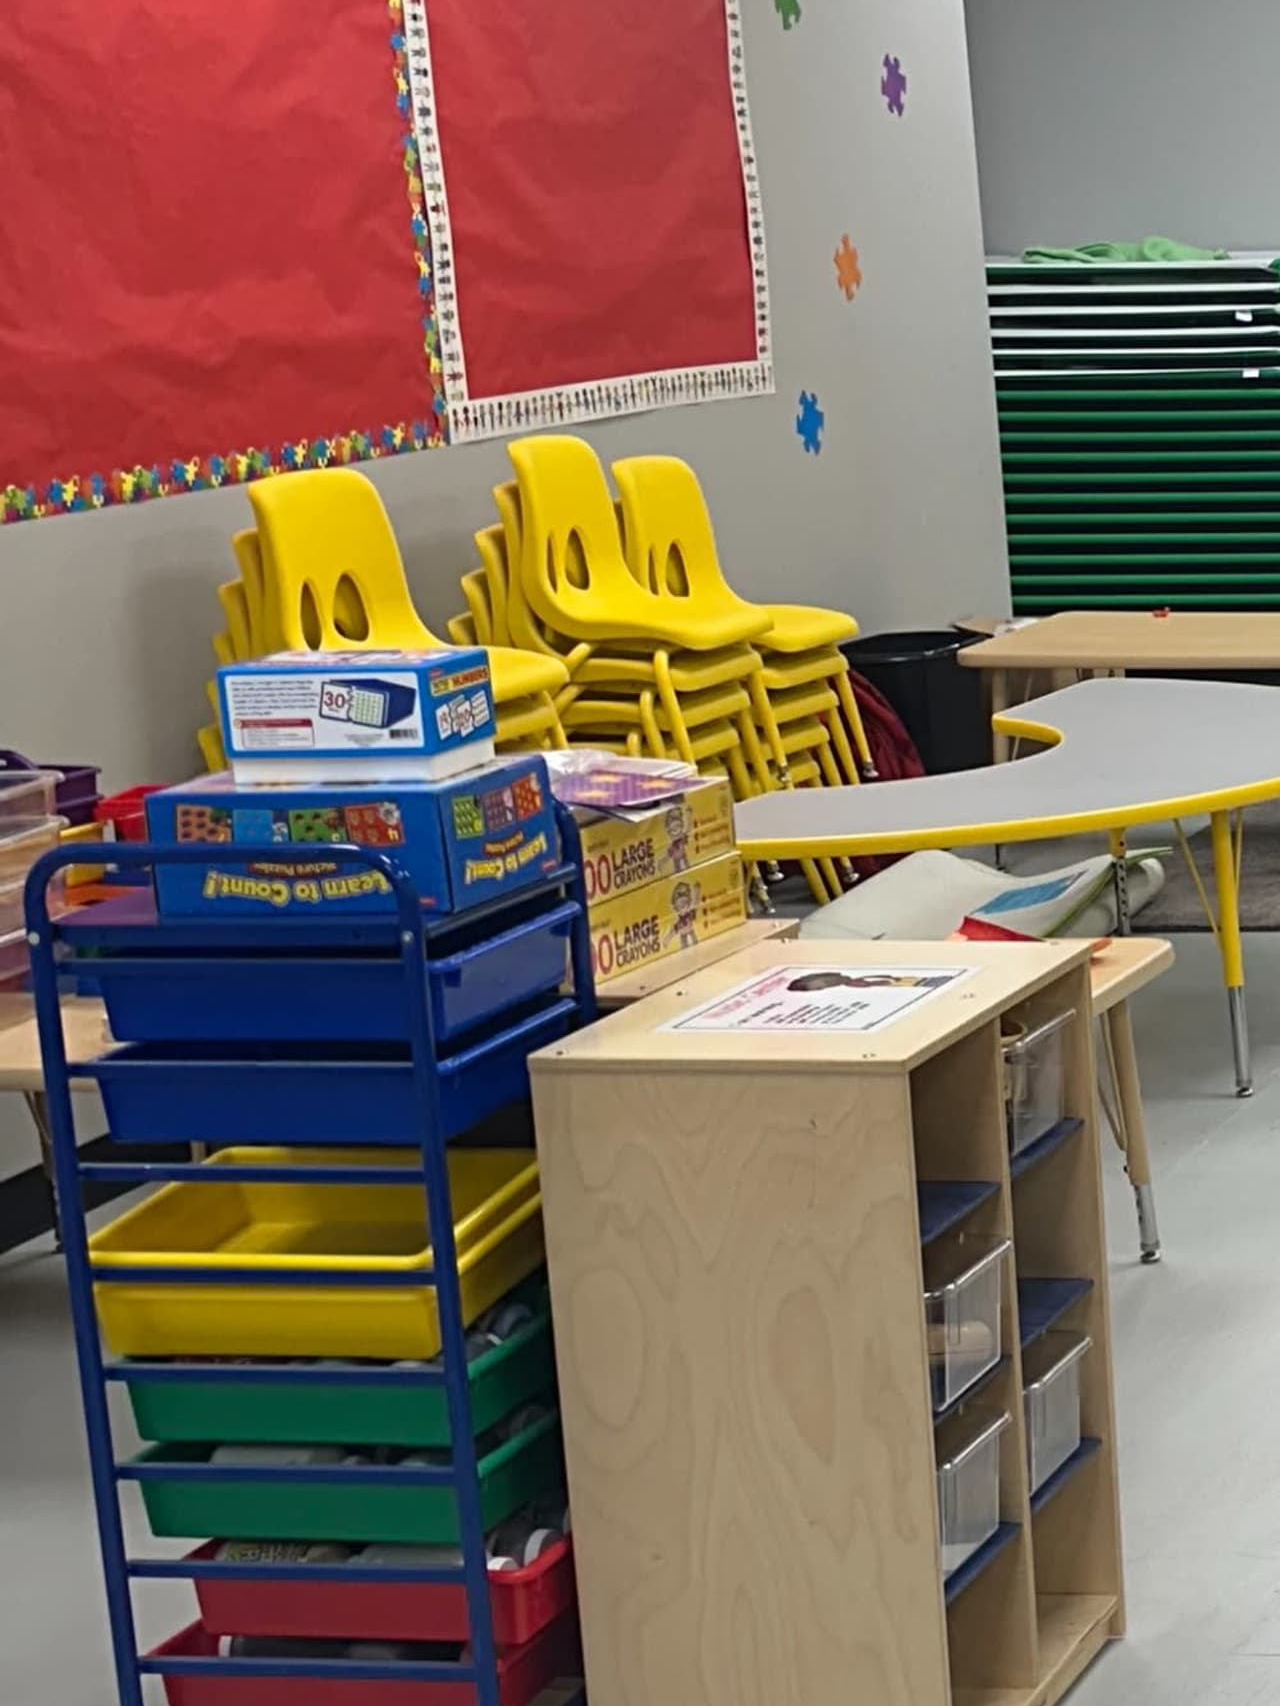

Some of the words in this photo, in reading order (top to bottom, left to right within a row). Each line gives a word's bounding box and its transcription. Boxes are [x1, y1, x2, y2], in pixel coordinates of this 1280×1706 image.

[323, 691, 346, 709] 30
[611, 838, 655, 871] LARGE
[203, 872, 290, 905] Count!
[323, 871, 391, 899] Learn
[614, 862, 656, 889] CRAYONS
[295, 882, 319, 902] to
[614, 914, 660, 949] LARGE
[616, 939, 661, 968] CRAYONS
